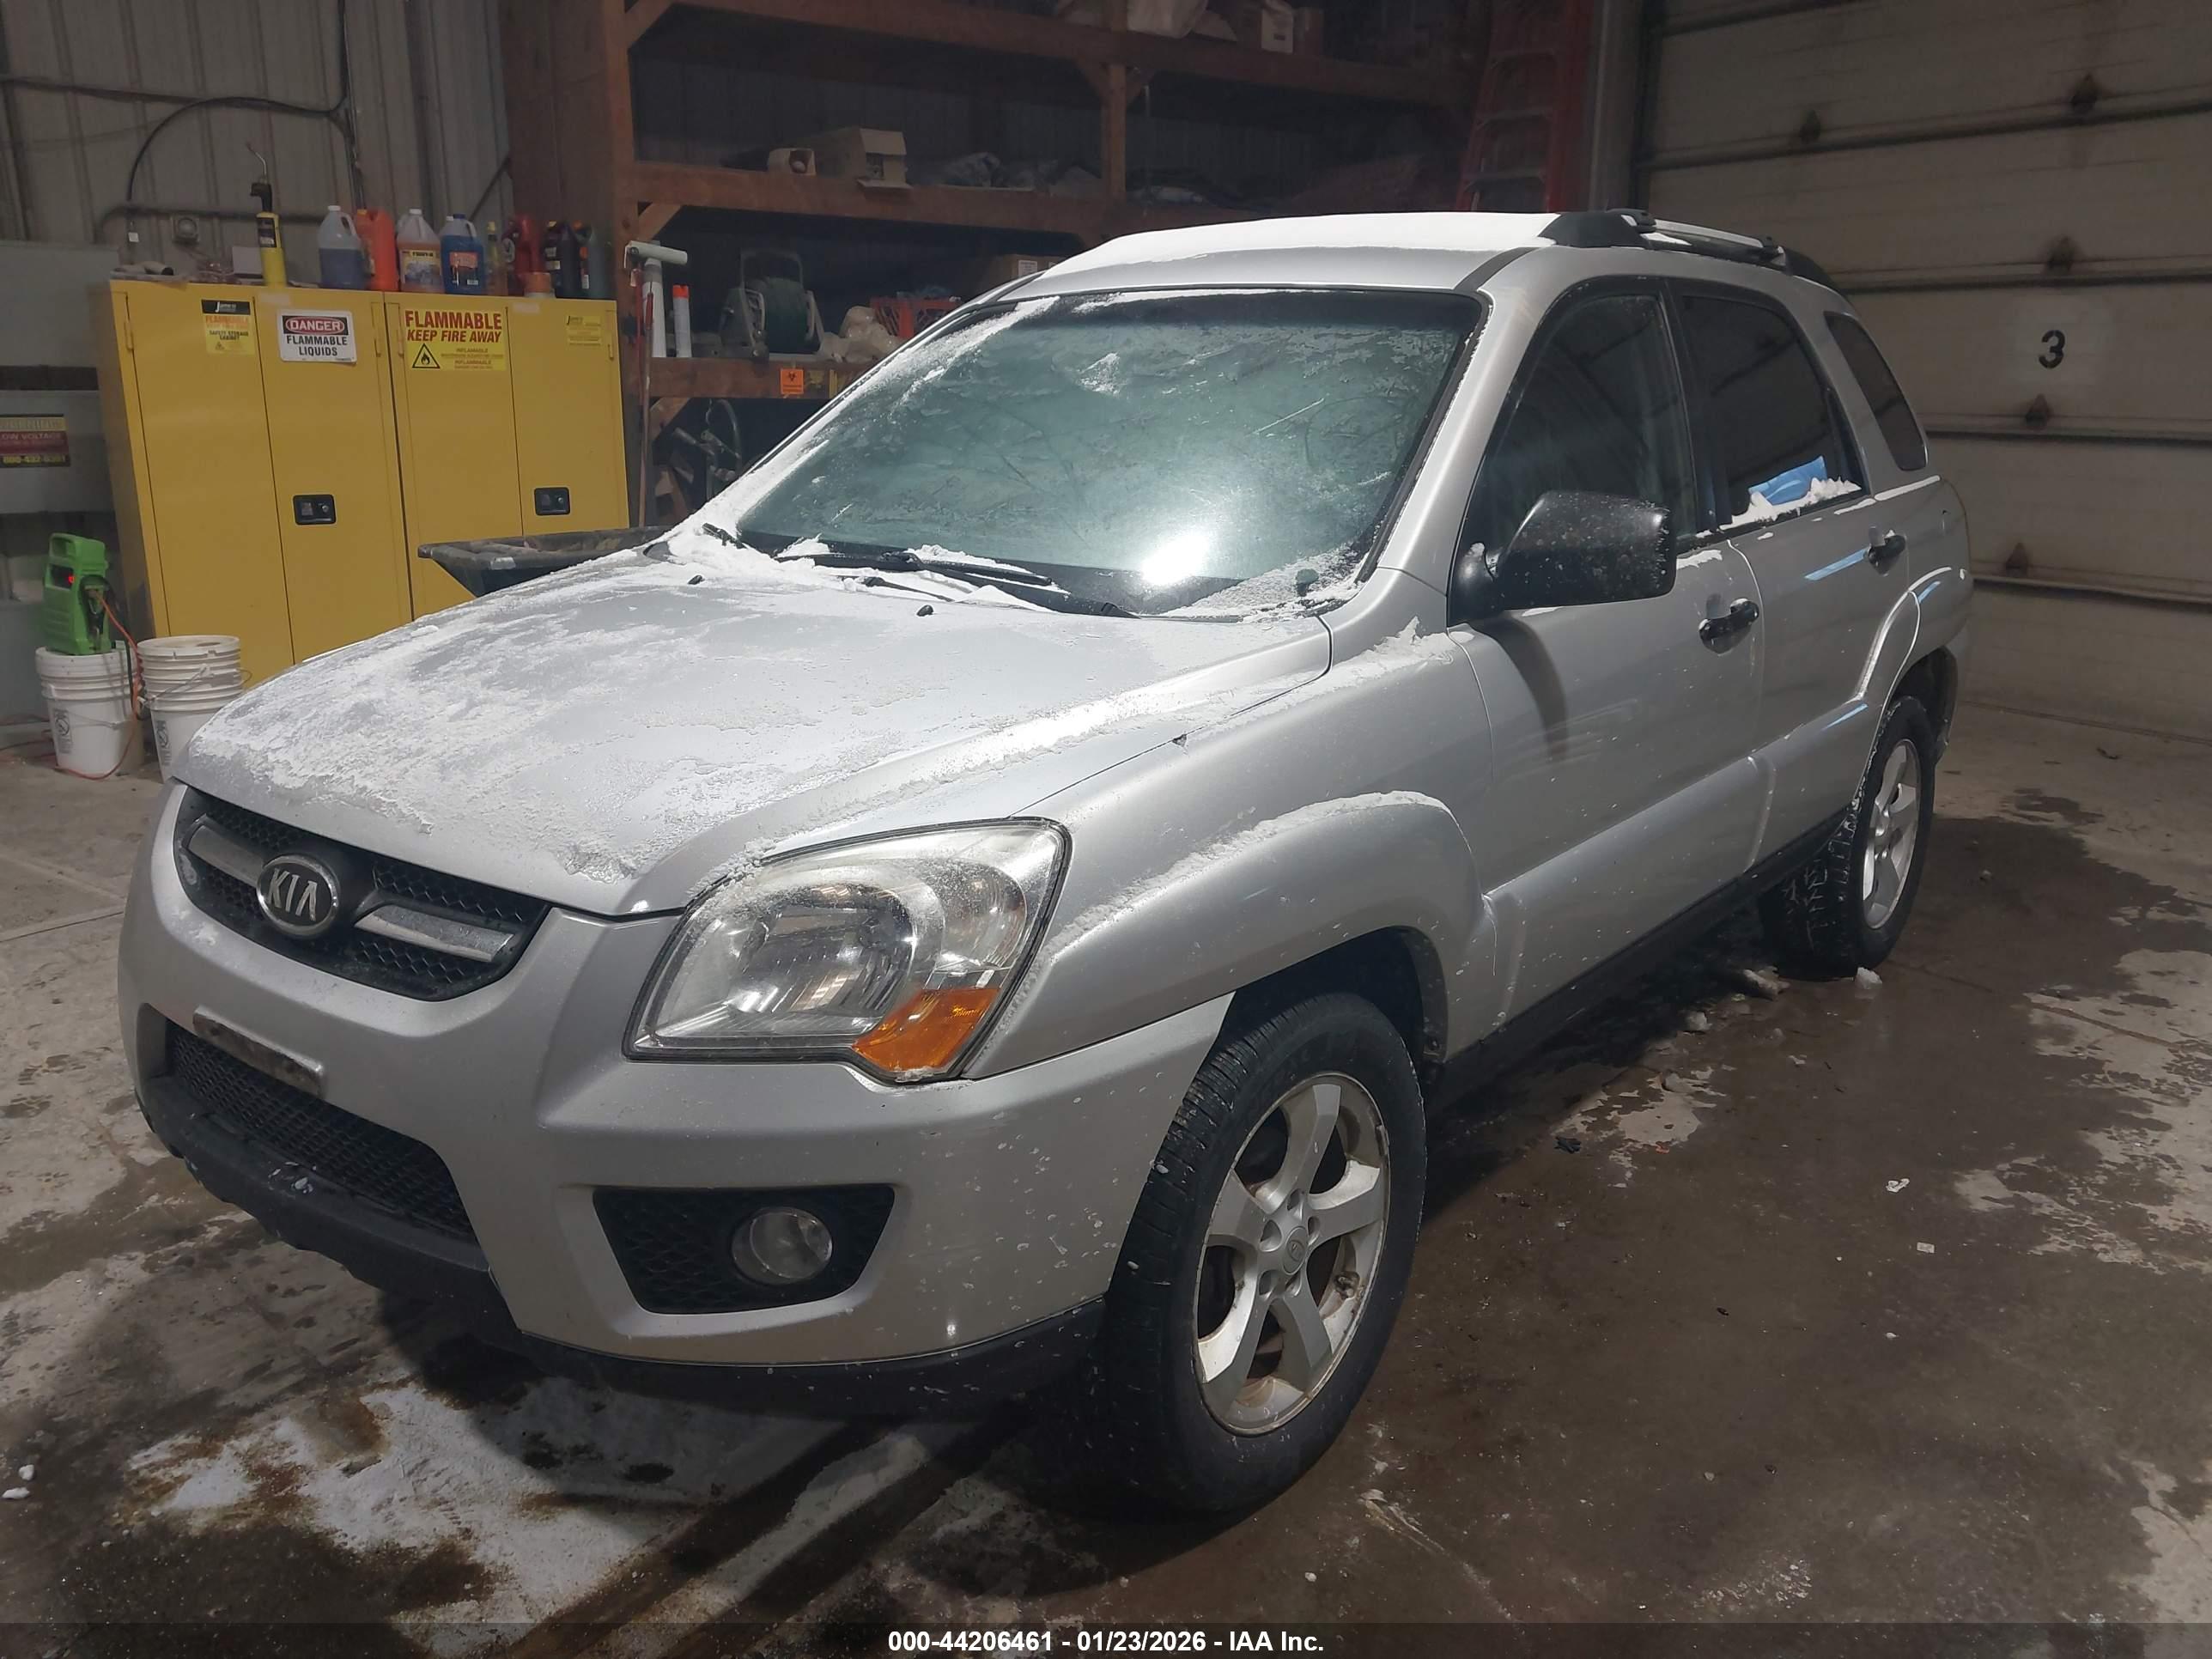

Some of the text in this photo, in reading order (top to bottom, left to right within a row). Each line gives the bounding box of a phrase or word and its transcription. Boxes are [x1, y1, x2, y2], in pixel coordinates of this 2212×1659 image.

[289, 319, 342, 332] DANGER
[405, 310, 502, 330] FLAMMABLE
[287, 335, 348, 346] FLAMMABLE
[407, 329, 502, 343] KEEP FIRE AWAY
[299, 346, 338, 357] LIQUIDS
[2038, 330, 2065, 369] 3
[266, 867, 318, 921] KIA
